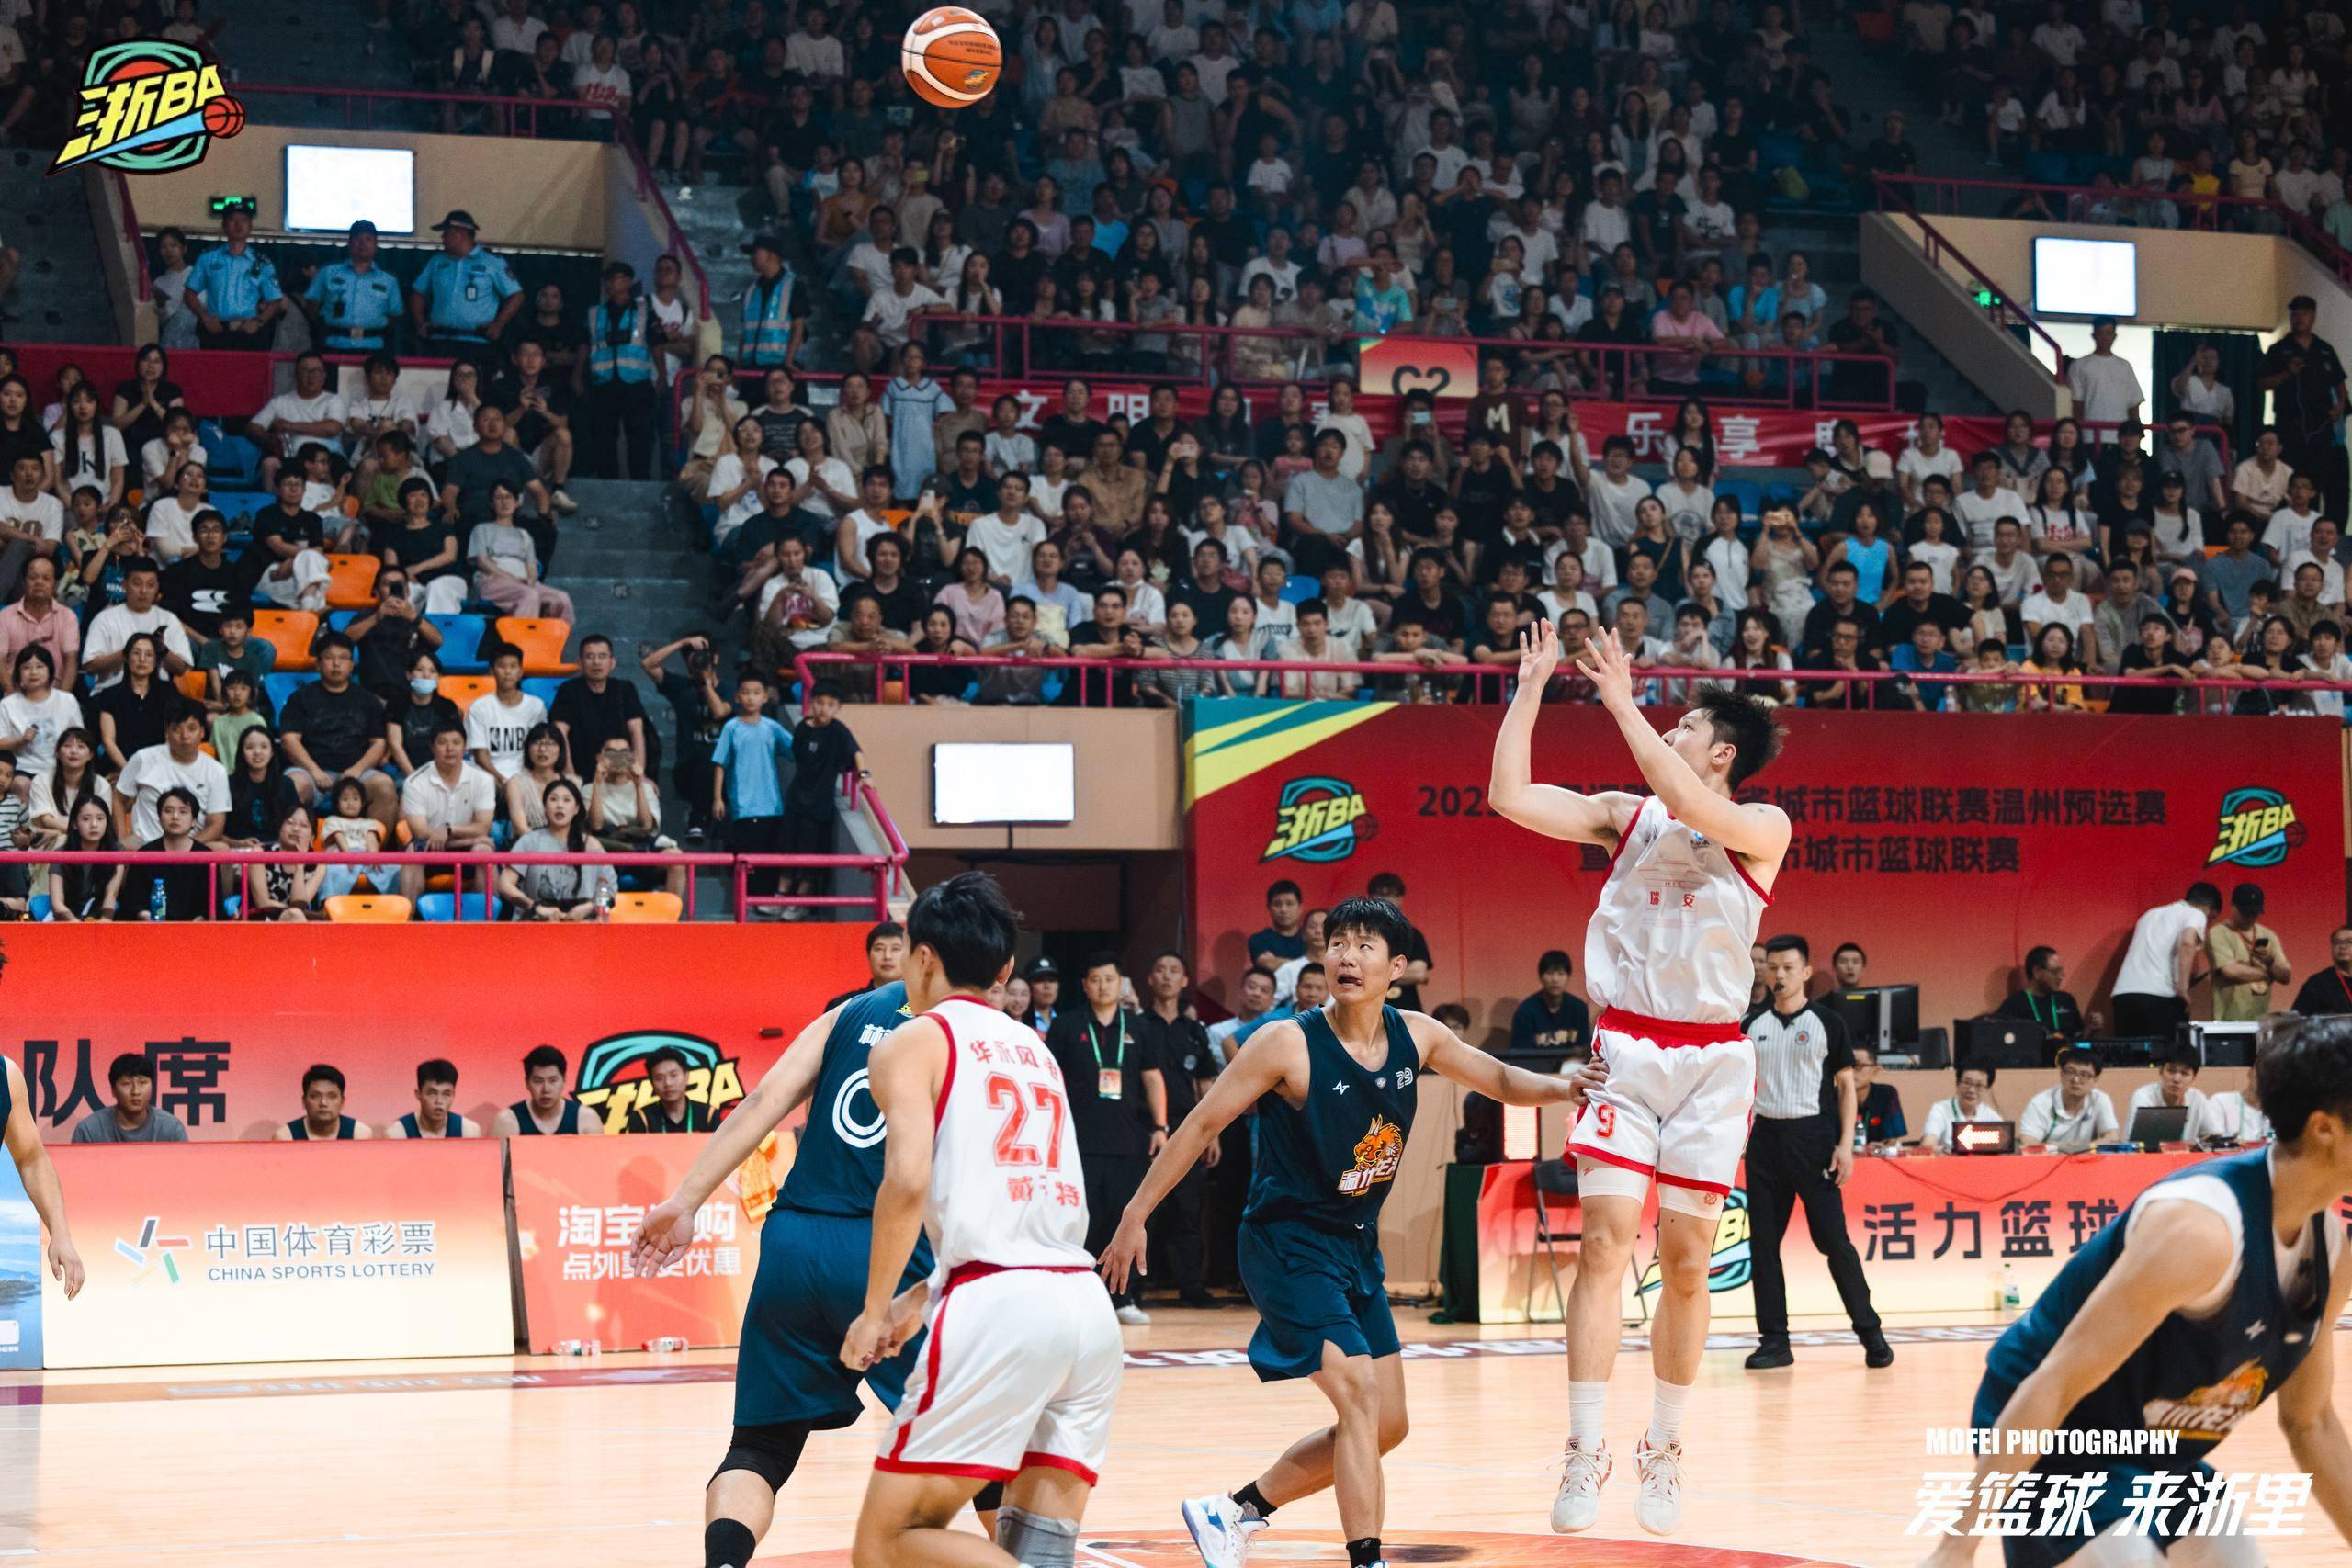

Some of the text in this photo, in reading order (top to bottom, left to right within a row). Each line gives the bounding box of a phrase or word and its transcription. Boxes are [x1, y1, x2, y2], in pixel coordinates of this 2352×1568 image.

[504, 727, 533, 751] NB
[1418, 785, 1499, 817] 202
[1396, 1066, 1414, 1090] 29
[985, 1071, 1067, 1172] 27
[1595, 1103, 1615, 1138] 9
[557, 1202, 737, 1247] 淘宝购
[207, 1224, 435, 1259] 中国体育彩票
[209, 1262, 435, 1281] CHINA SPORTS LOTTERY
